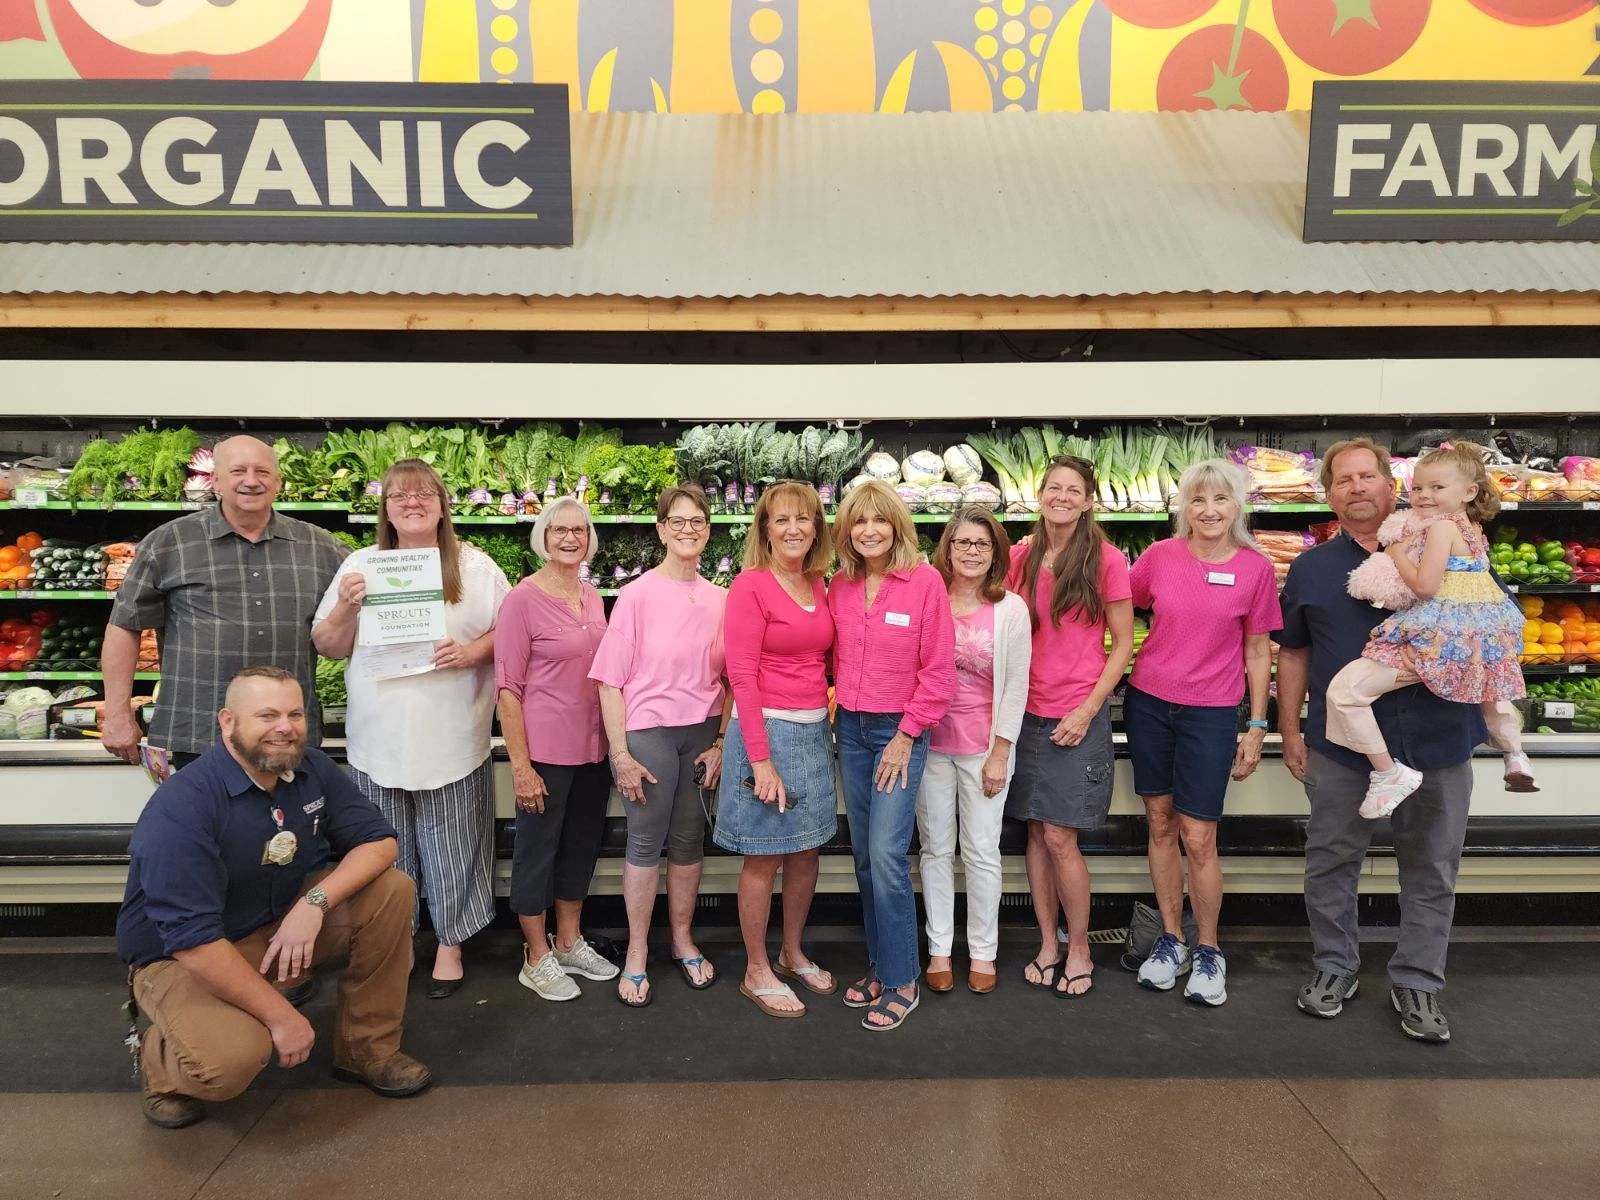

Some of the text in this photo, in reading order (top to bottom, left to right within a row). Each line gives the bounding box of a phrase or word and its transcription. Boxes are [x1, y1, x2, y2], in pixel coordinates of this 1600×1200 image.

[0, 116, 534, 209] ORGANIC
[1333, 122, 1598, 197] FARM
[367, 554, 430, 564] GROWING HEALTHY
[377, 607, 431, 620] SPROUTS
